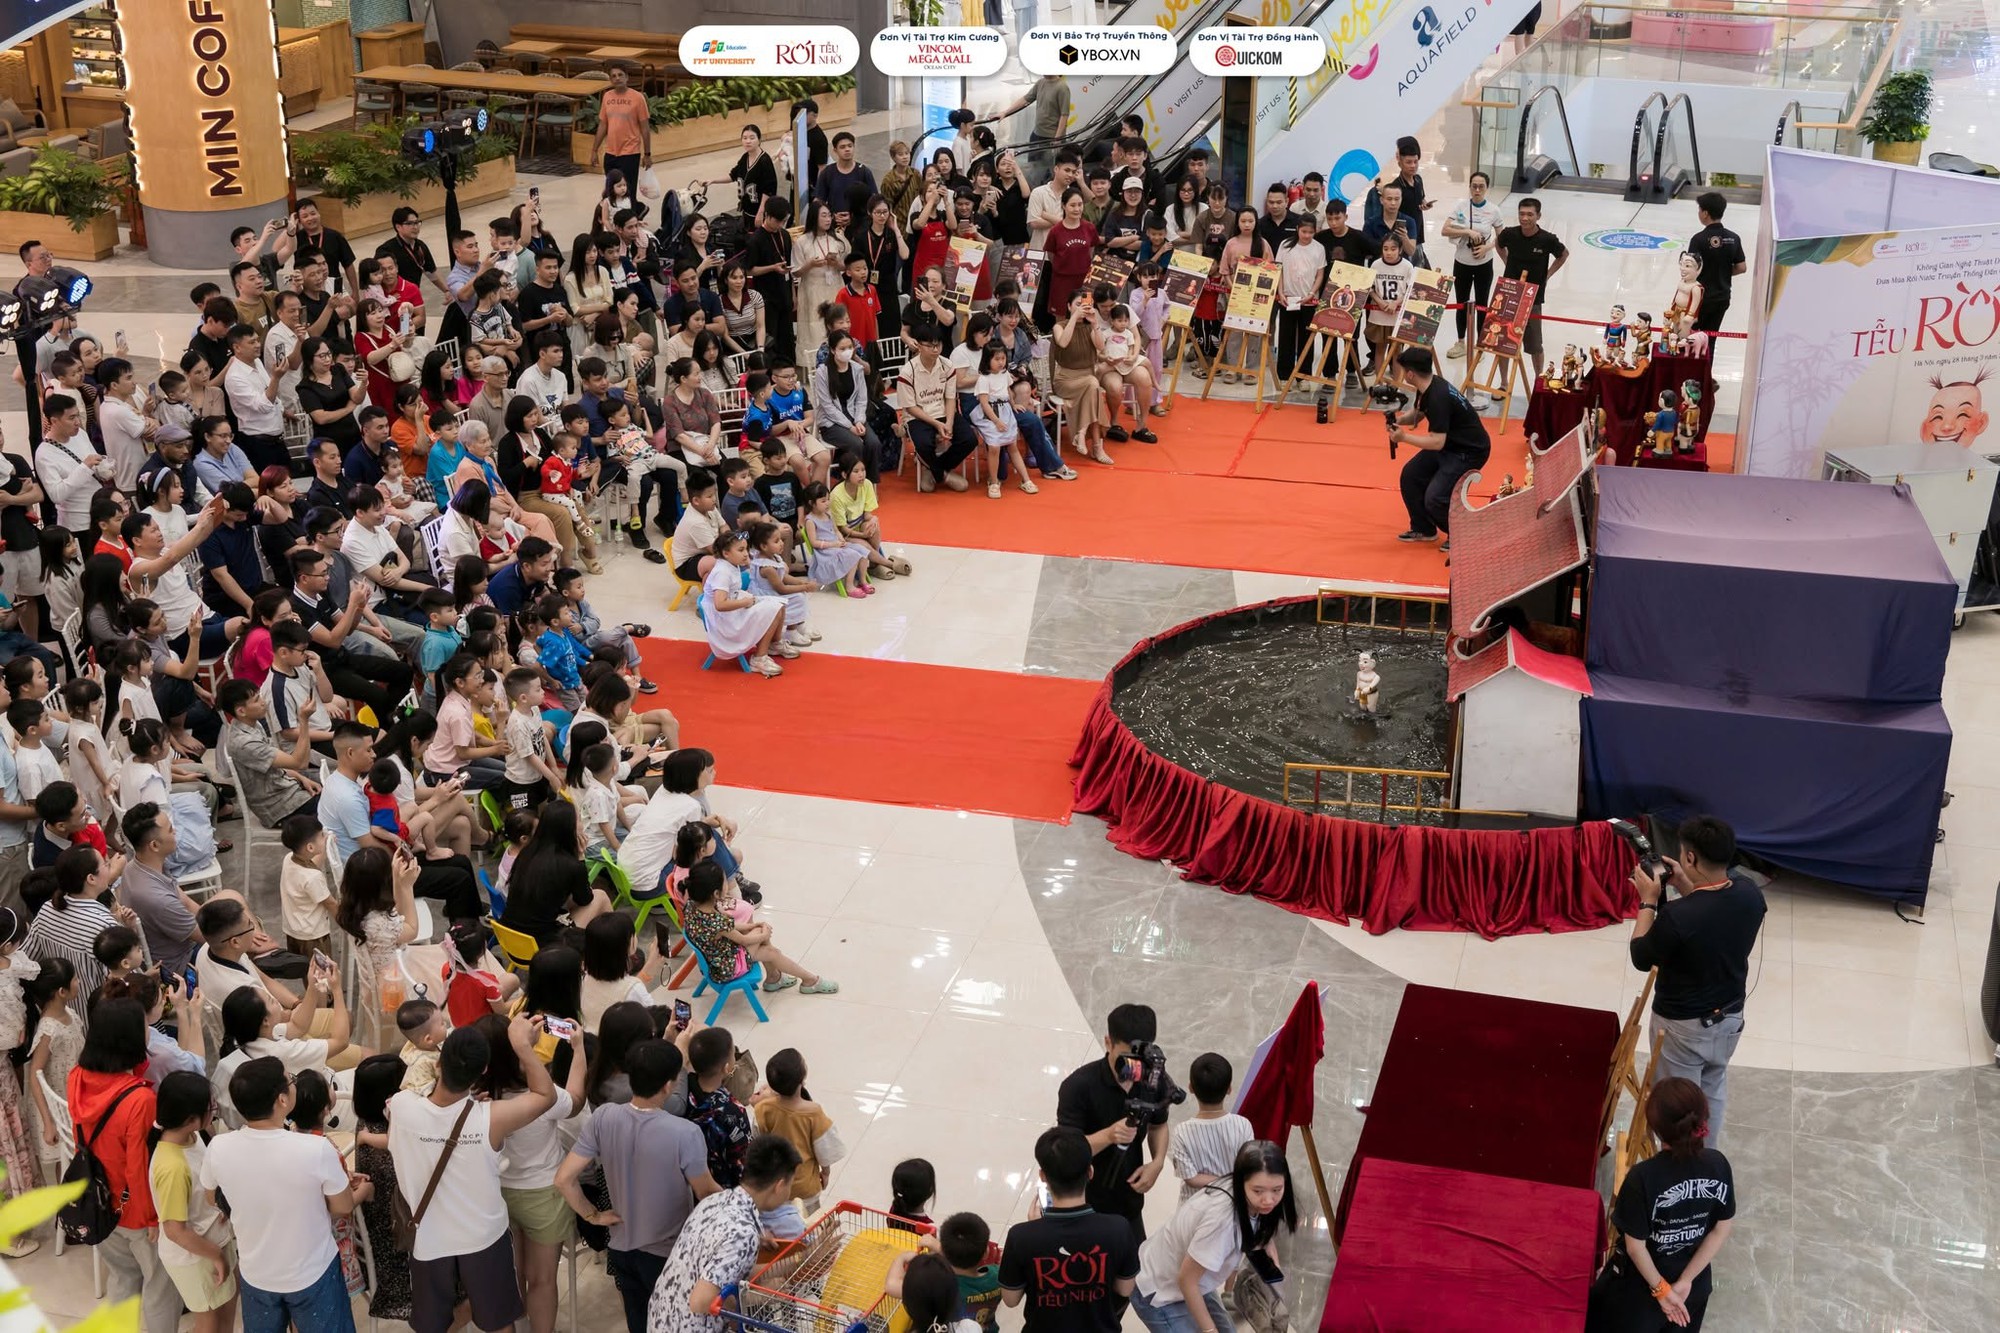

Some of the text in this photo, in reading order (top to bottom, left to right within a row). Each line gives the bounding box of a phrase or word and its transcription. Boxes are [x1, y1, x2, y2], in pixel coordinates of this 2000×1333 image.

[1397, 7, 1477, 97] AQUAFIELD
[1088, 75, 1104, 87] VIS
[1174, 78, 1205, 109] VISIT US
[1269, 92, 1283, 109] US
[202, 110, 242, 196] MIN
[1939, 262, 1954, 270] Gian
[1382, 280, 1398, 301] 12
